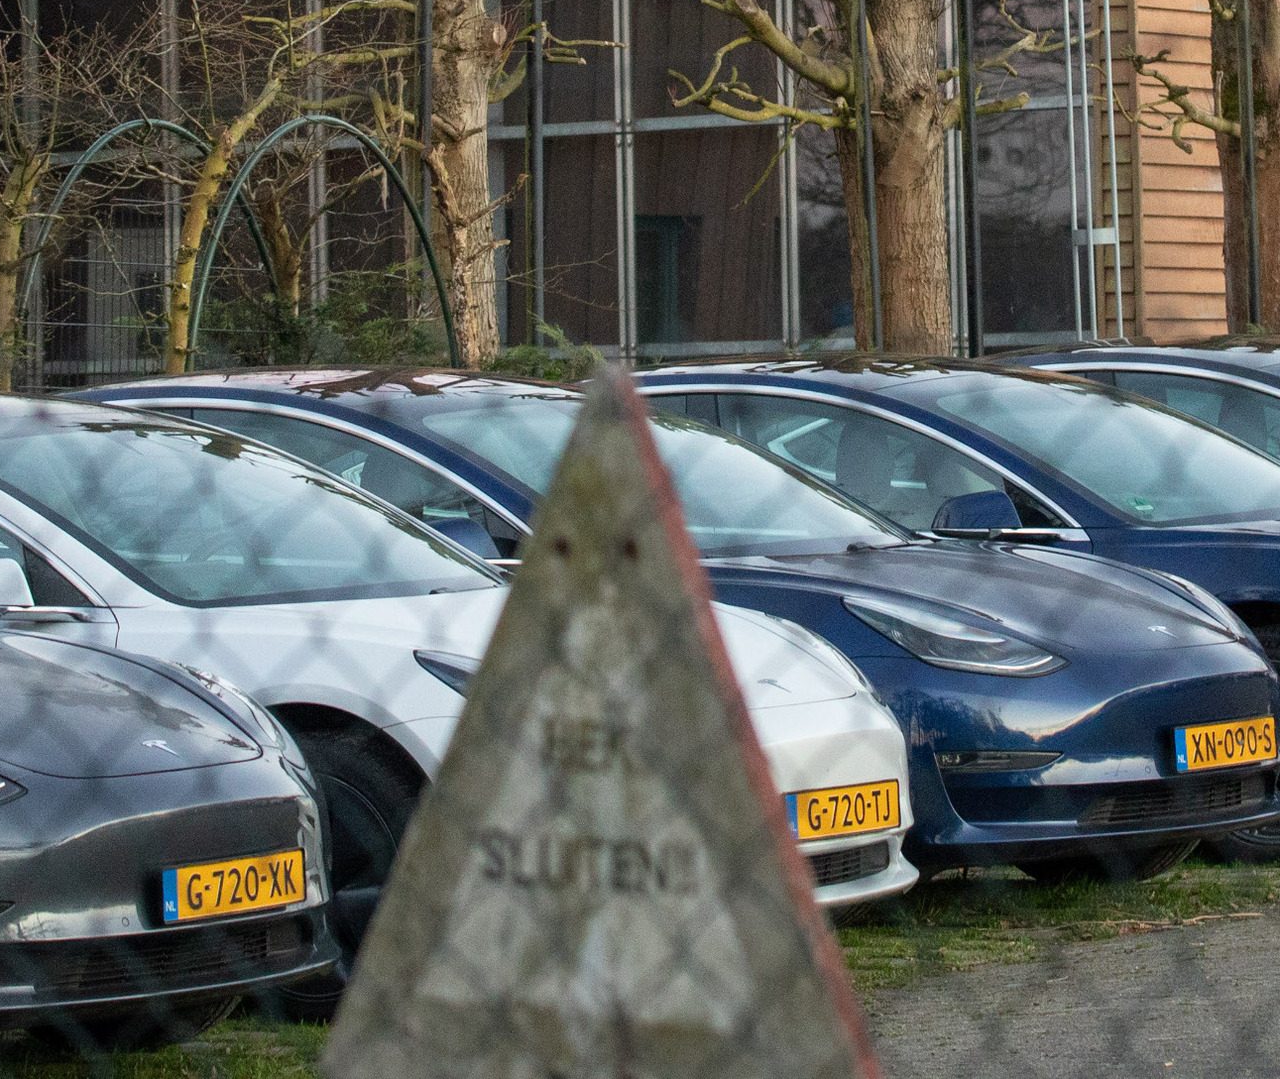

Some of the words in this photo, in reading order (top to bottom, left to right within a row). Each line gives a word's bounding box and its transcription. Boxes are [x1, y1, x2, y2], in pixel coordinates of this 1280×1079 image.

[1191, 723, 1272, 763] XN-090-S
[807, 788, 890, 831] G-720-TJ
[165, 901, 176, 911] NL
[186, 858, 297, 910] G-720-XK
